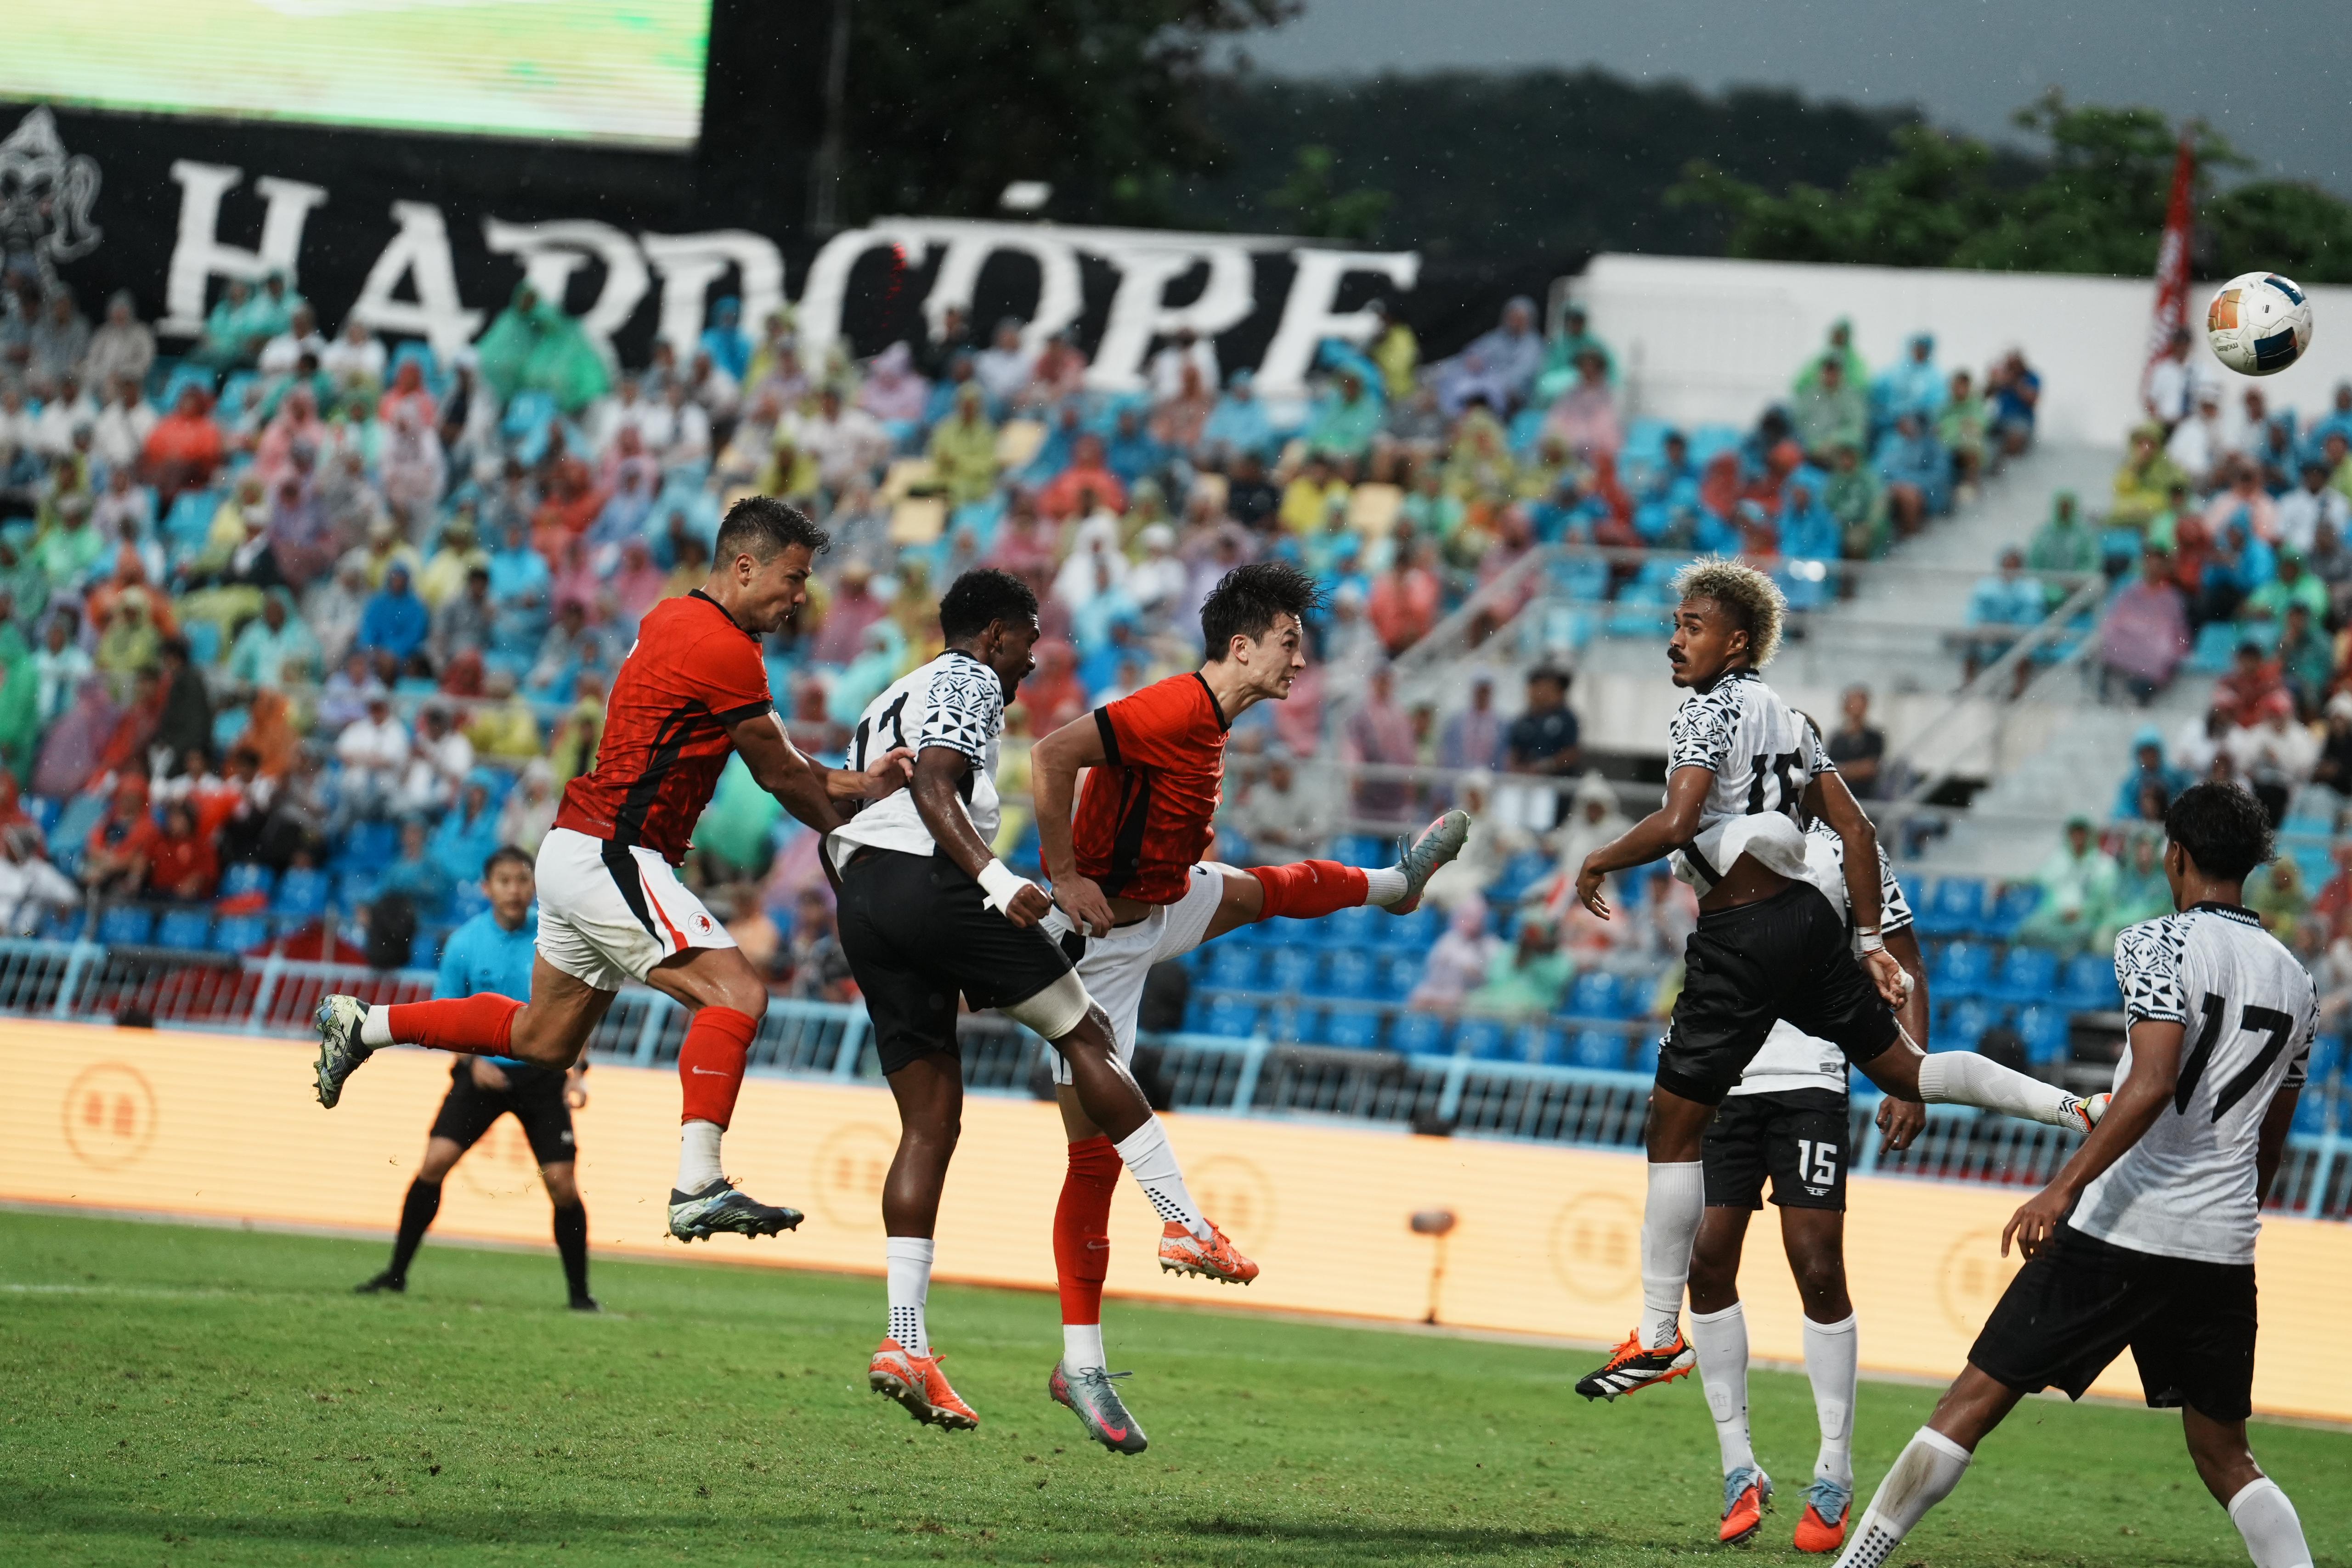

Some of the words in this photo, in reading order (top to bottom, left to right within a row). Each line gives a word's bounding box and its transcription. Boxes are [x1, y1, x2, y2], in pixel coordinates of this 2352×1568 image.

[156, 158, 1422, 400] HARDCORE
[2175, 992, 2294, 1123] 17
[1798, 1139, 1837, 1185] 15
